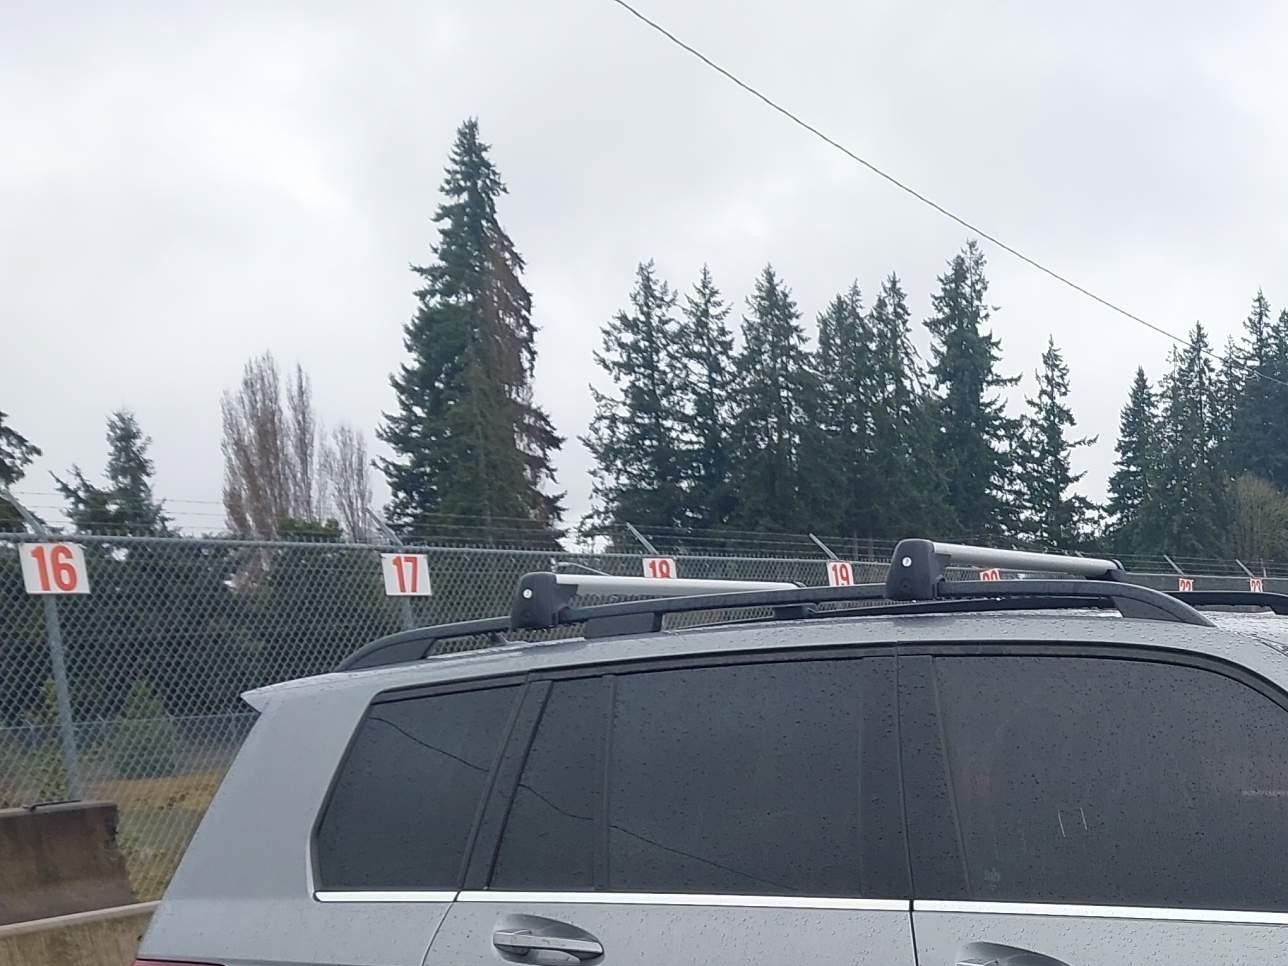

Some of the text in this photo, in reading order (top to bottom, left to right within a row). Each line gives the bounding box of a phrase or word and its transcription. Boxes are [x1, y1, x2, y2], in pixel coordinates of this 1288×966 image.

[31, 545, 77, 591] 16
[392, 556, 417, 592] 17
[832, 563, 850, 586] 19
